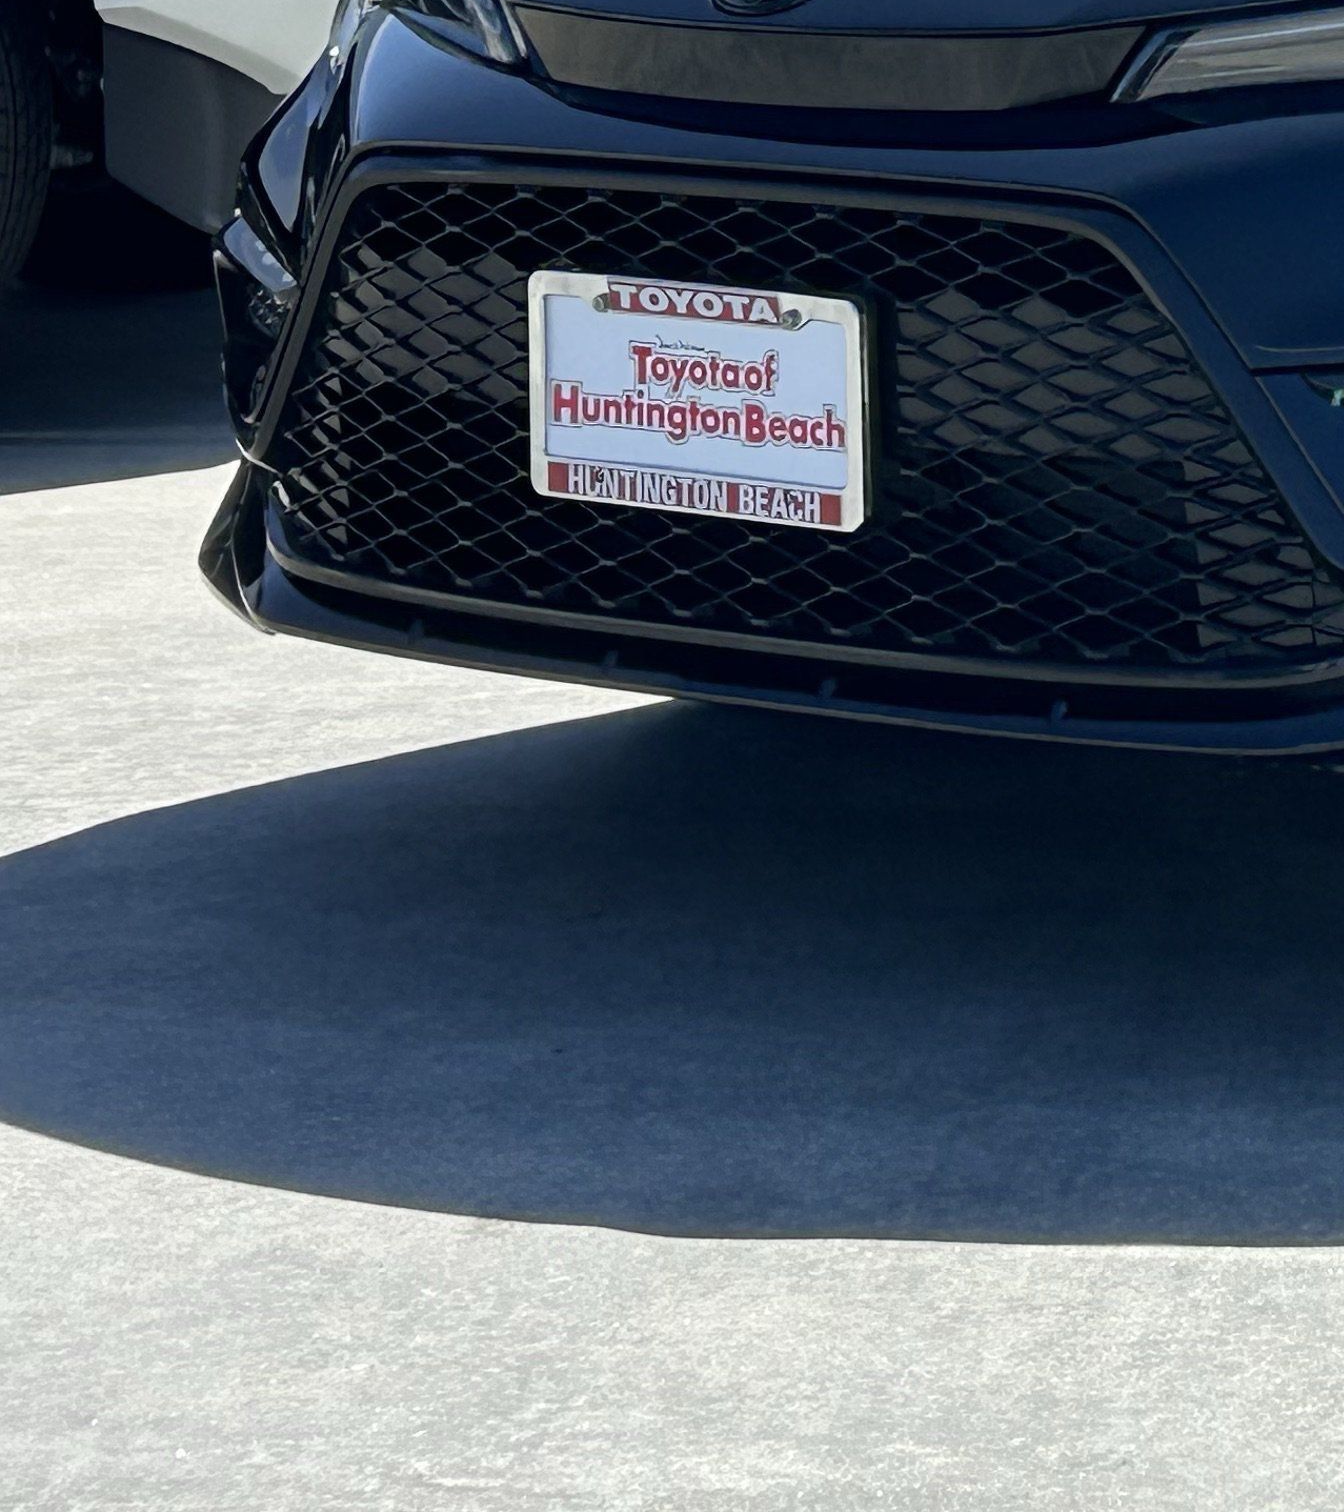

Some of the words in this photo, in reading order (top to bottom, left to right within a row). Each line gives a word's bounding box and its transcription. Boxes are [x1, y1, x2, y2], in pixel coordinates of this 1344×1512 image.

[610, 285, 778, 324] TOYOTA
[631, 344, 742, 393] Toyota
[744, 352, 778, 394] of
[552, 382, 741, 440] Huntington
[744, 402, 846, 448] Beach
[567, 464, 728, 513] HUNTINGTON
[738, 484, 821, 524] BEACH
